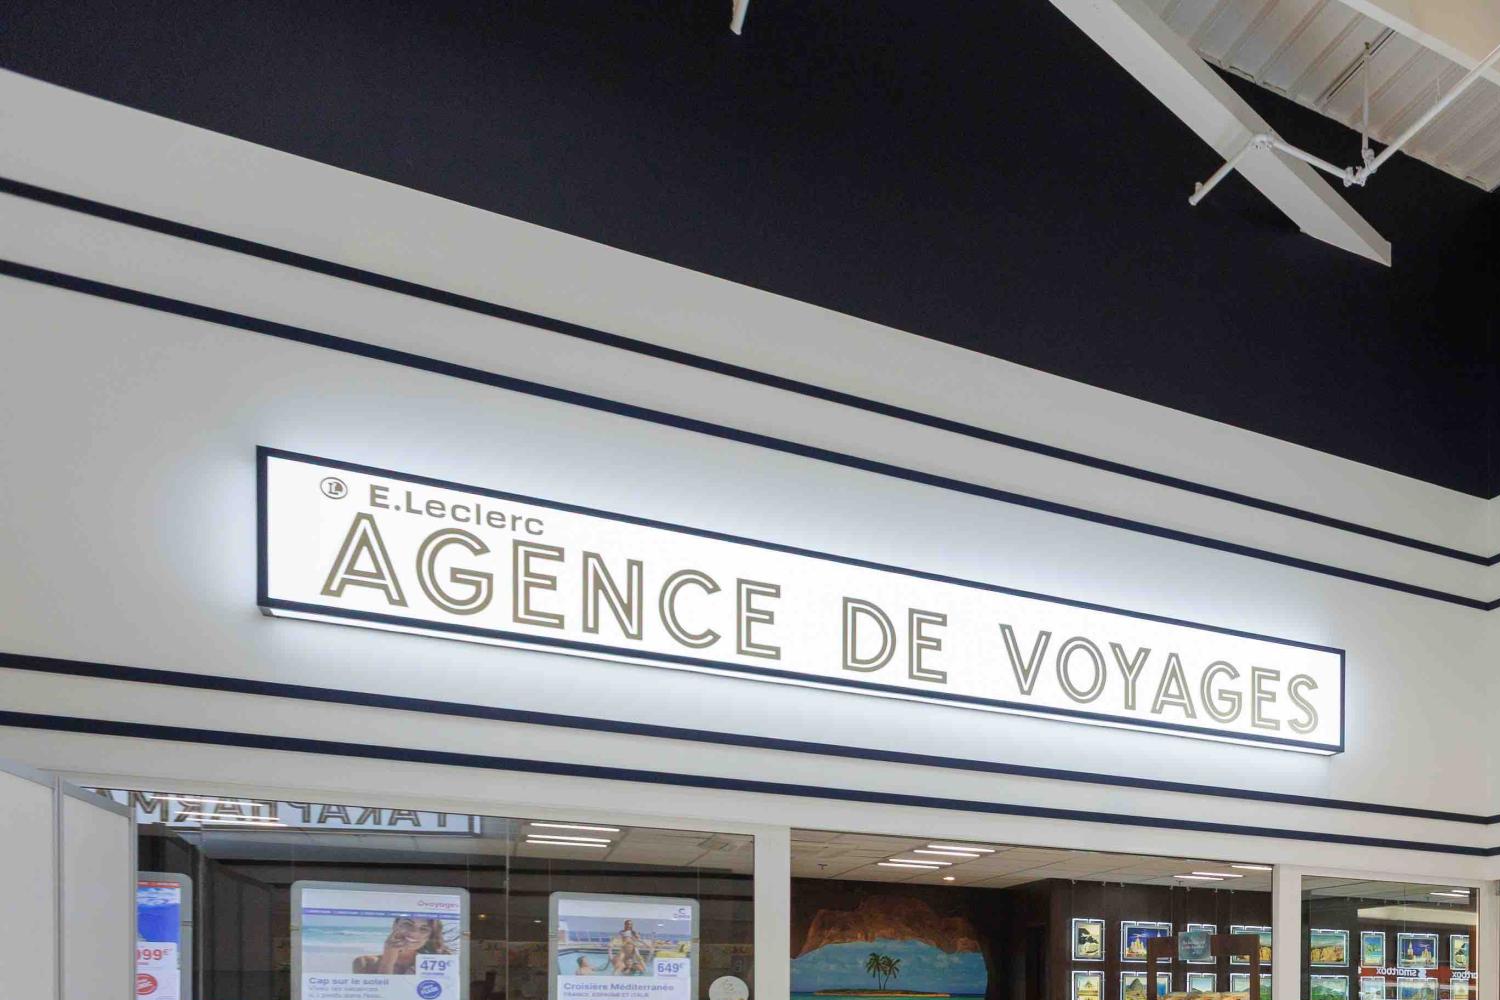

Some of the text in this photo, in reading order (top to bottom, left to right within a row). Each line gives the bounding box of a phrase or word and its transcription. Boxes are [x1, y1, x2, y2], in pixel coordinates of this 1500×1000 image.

[369, 483, 545, 536] E.Leclerc
[320, 511, 1320, 735] AGENCE DE VOYAGES
[308, 977, 330, 987] Cap
[563, 981, 675, 992] Croisière Méditerranée
